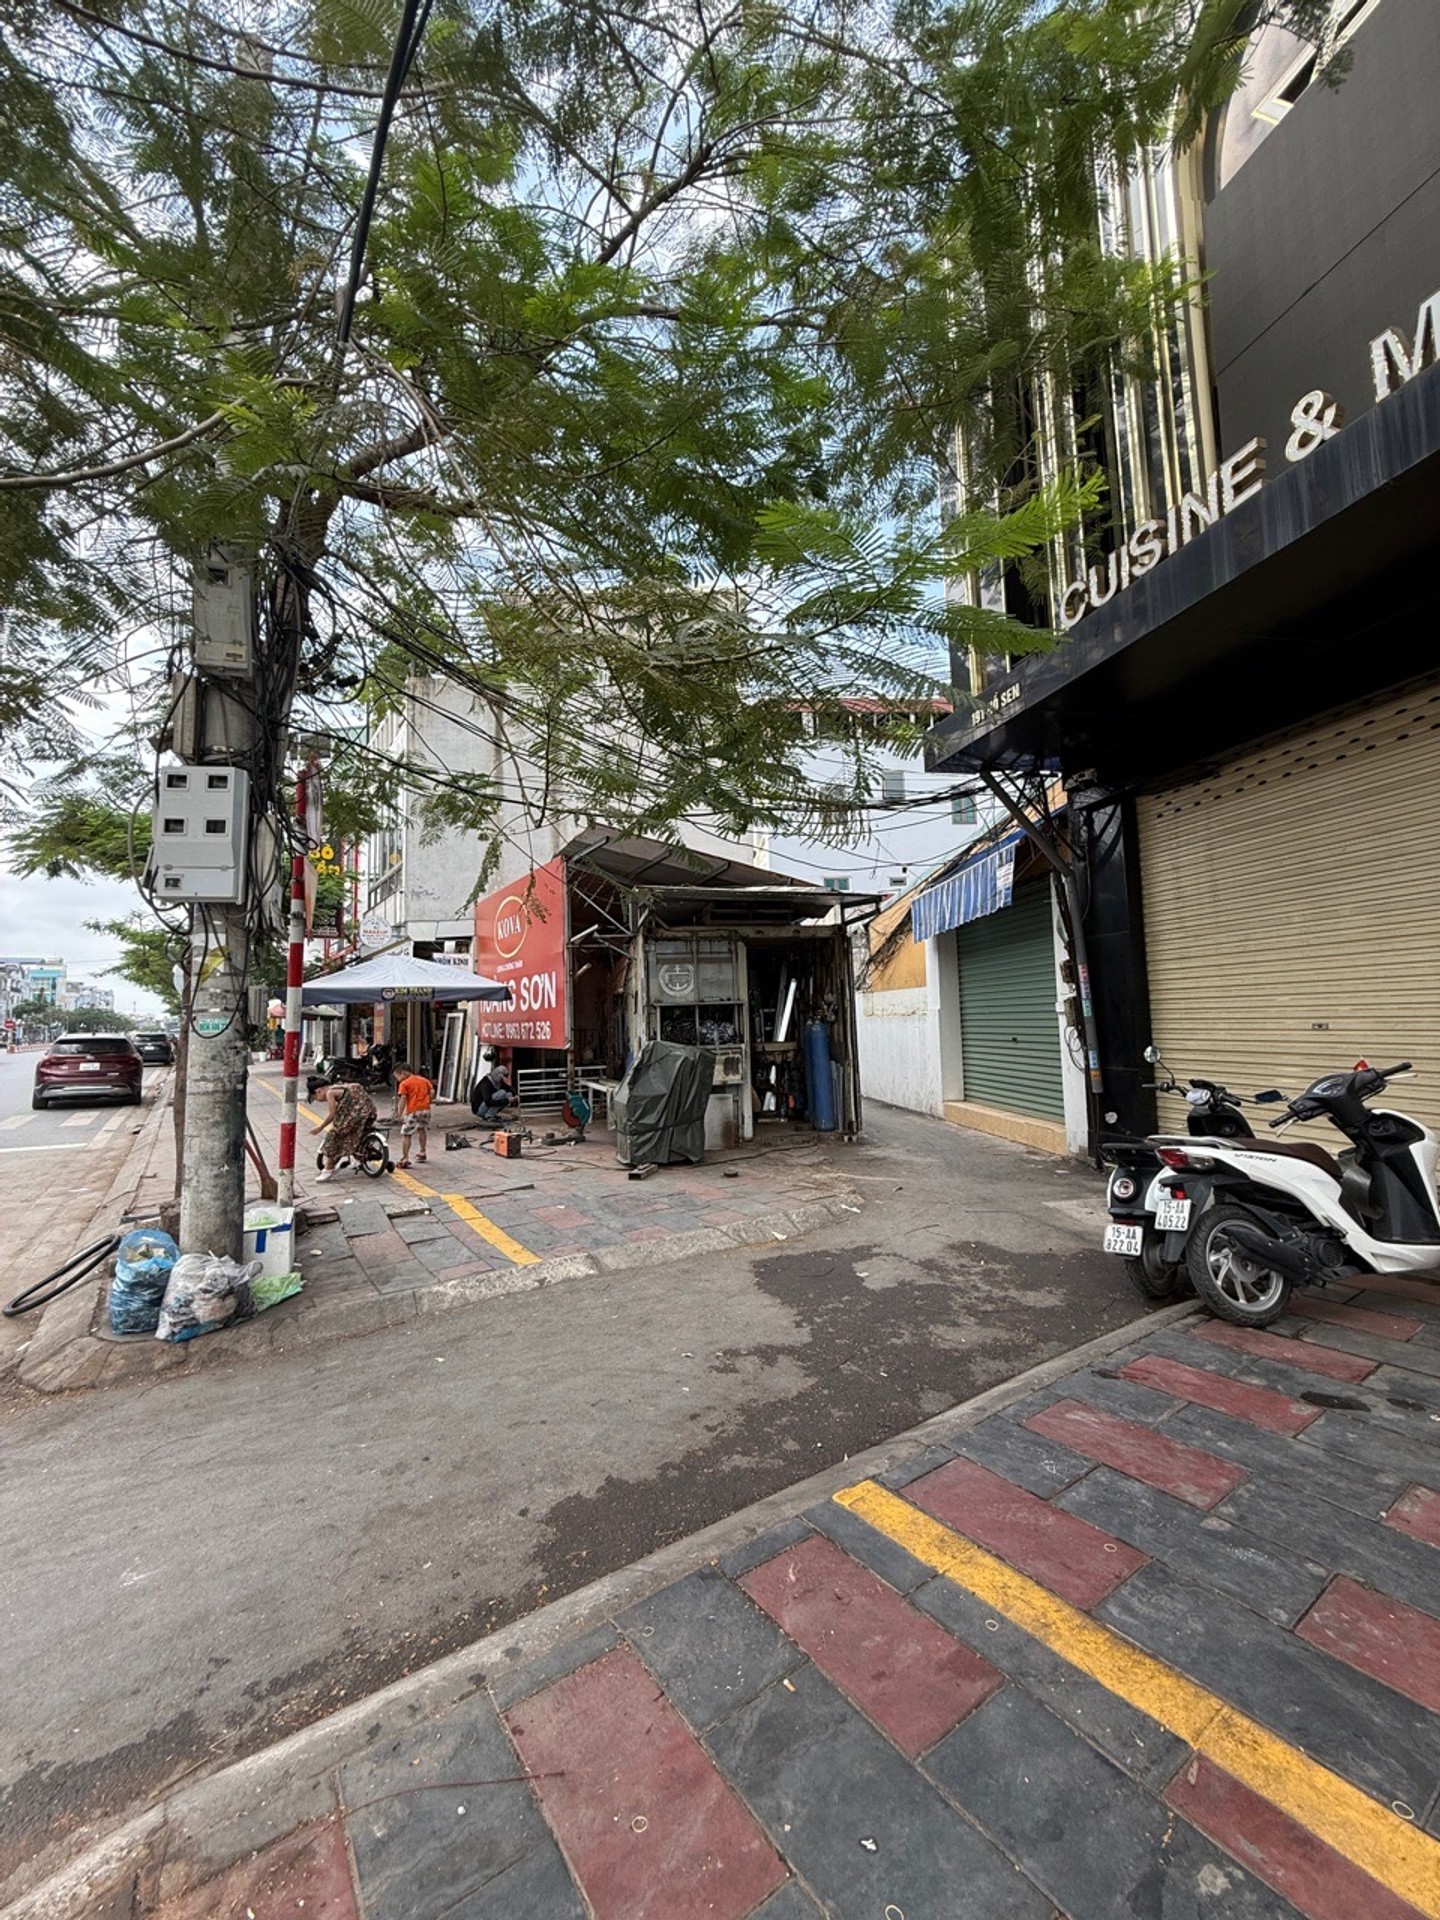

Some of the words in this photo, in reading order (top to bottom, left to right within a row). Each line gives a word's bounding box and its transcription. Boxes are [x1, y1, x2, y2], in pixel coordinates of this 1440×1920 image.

[1060, 437, 1267, 628] CUISINE
[1285, 390, 1344, 462] &
[971, 709, 985, 726] 191
[1001, 683, 1020, 707] SEN
[497, 914, 522, 940] KOVA
[520, 971, 556, 1012] SƠN
[536, 1020, 552, 1040] 526
[1111, 1227, 1137, 1240] 15-AA
